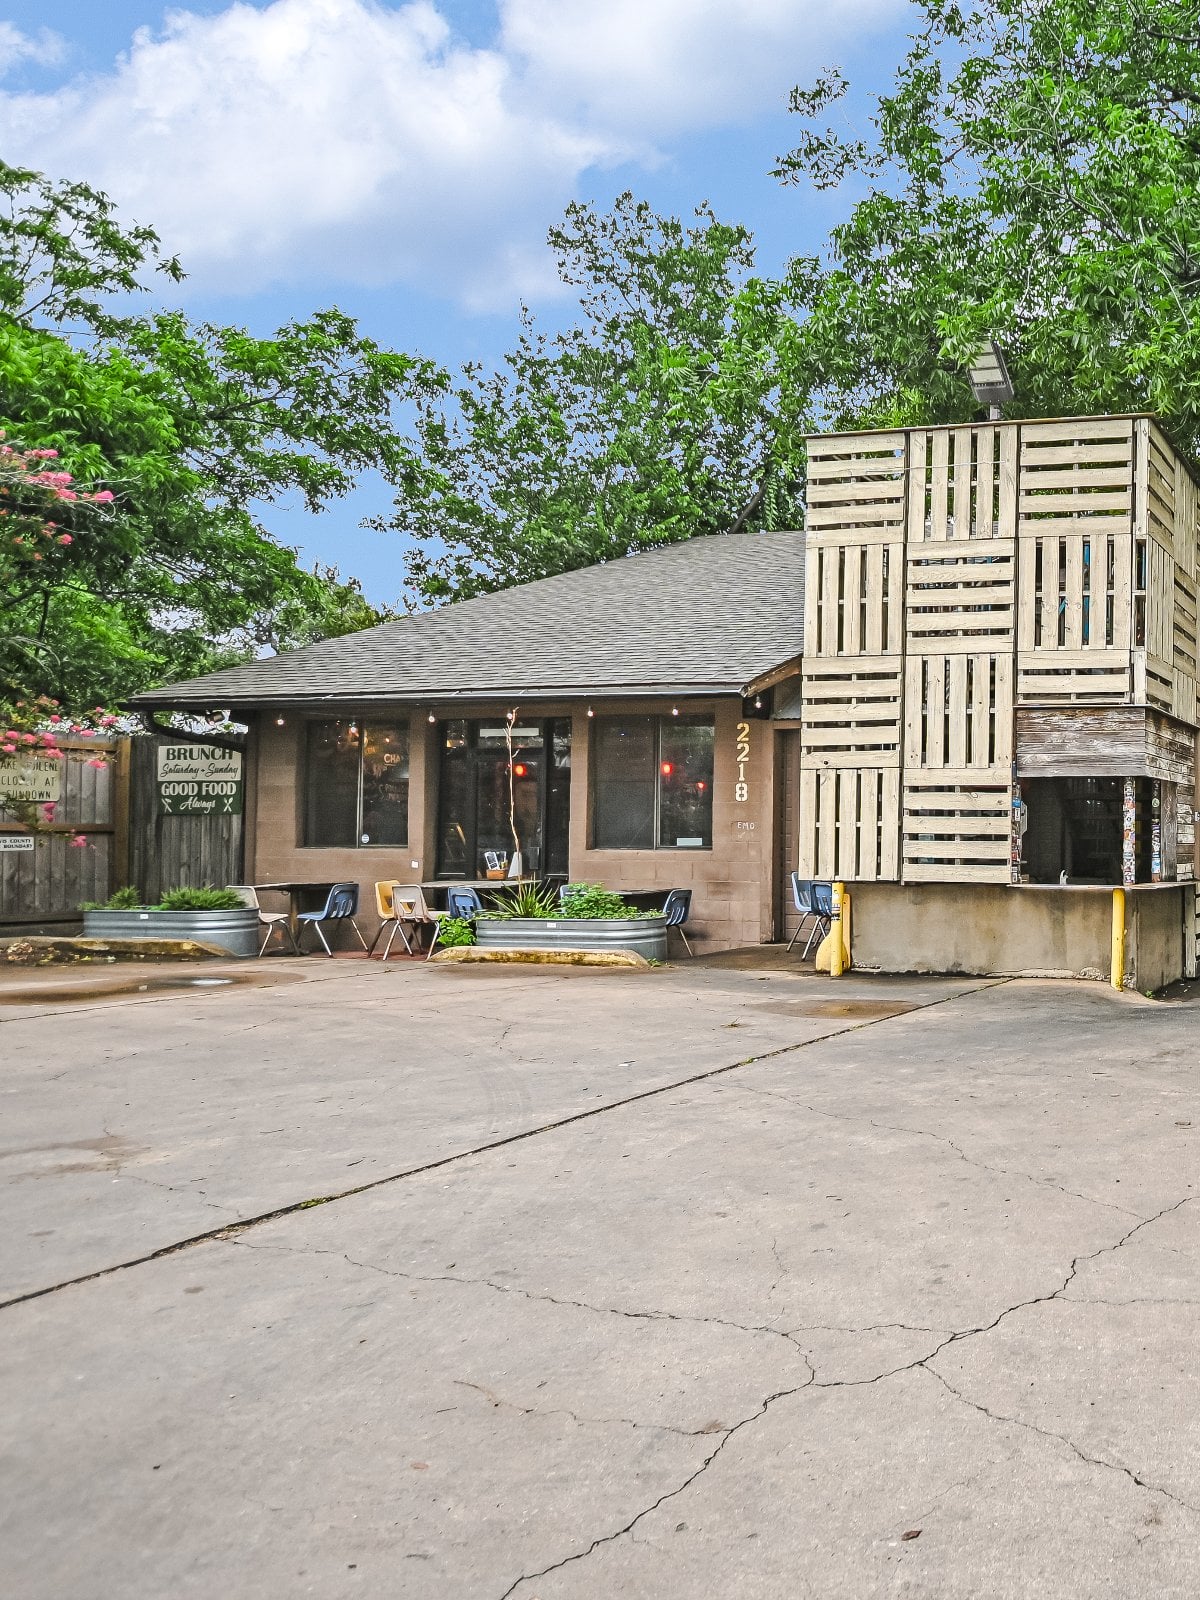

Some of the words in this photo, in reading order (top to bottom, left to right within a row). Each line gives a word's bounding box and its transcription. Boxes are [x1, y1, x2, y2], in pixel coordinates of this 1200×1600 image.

[166, 747, 233, 761] BRUNCH
[735, 722, 750, 802] 2218
[160, 762, 200, 780] Saturday
[204, 762, 239, 780] Sunday
[44, 776, 56, 787] AT
[160, 782, 199, 796] GOOD
[201, 782, 237, 796] FOOD
[179, 796, 216, 814] Always
